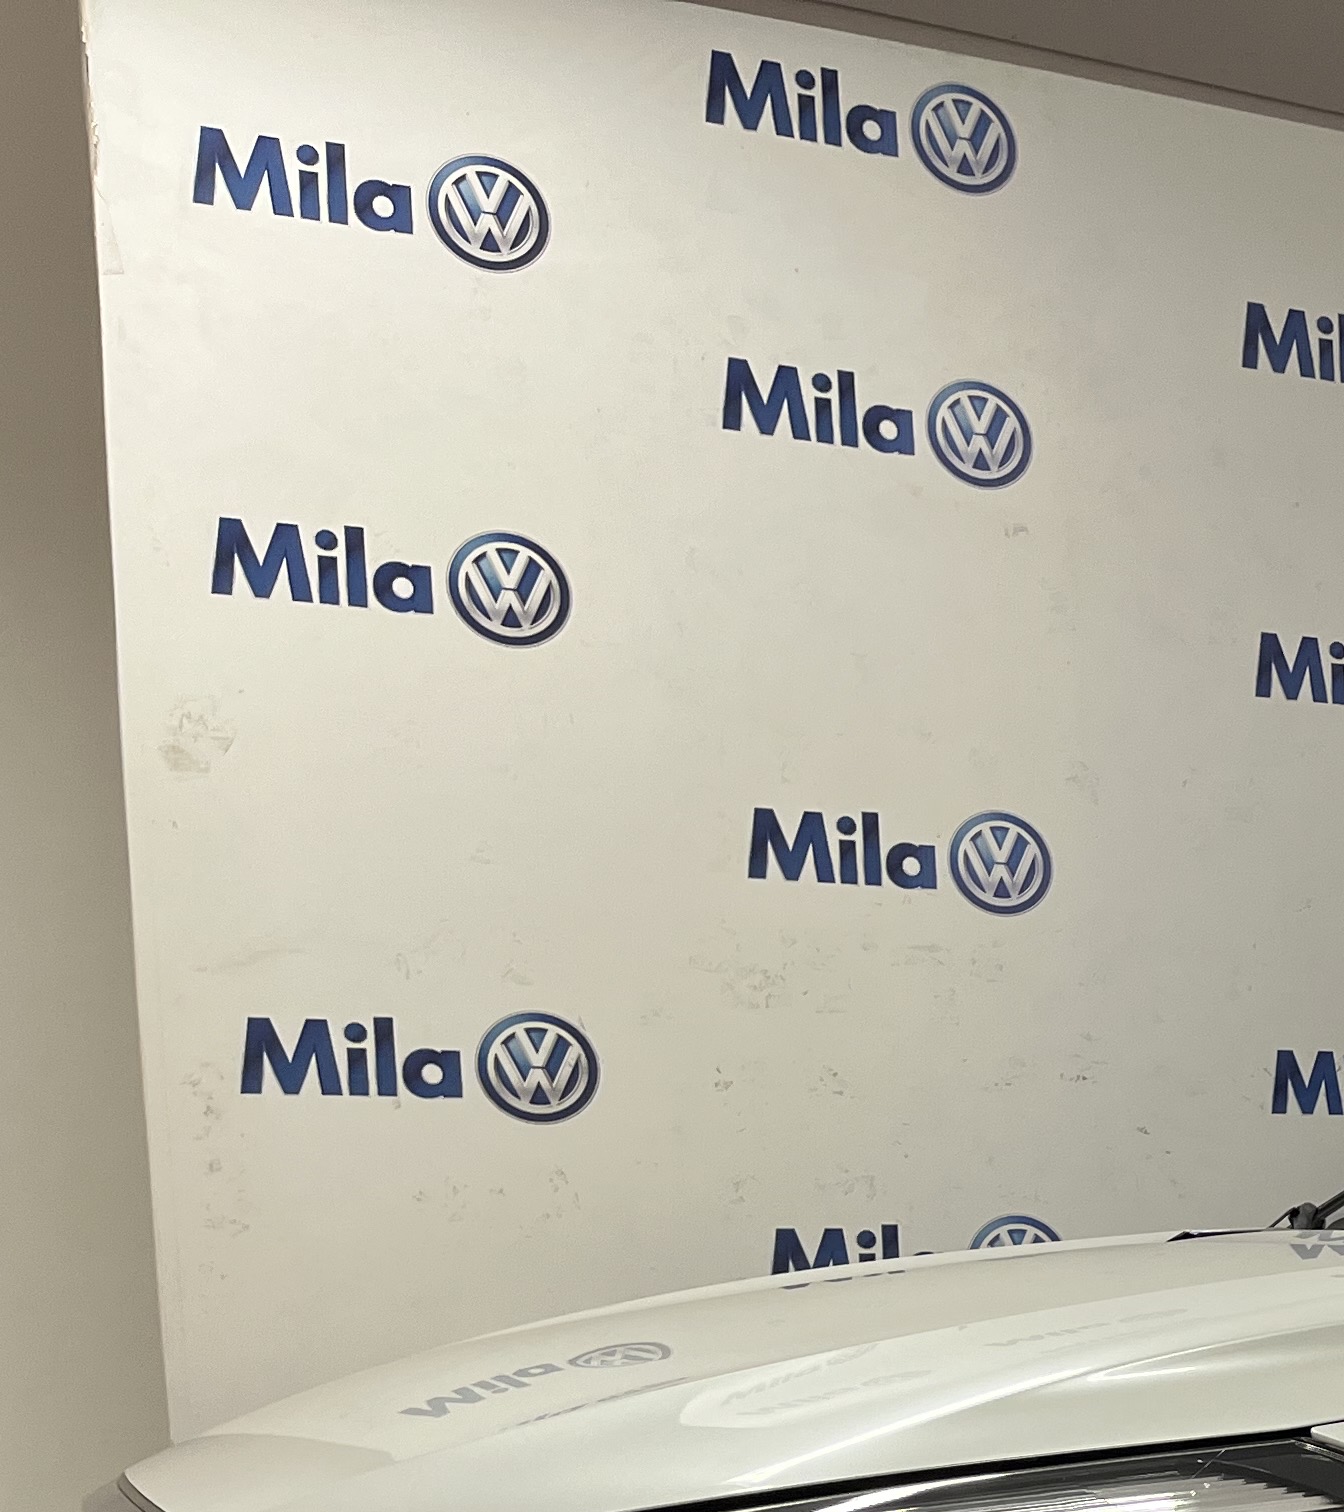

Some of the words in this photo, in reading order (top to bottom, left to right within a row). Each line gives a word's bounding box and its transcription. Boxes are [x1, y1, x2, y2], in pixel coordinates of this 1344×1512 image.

[706, 50, 898, 157] Mila
[918, 90, 1010, 186] VW
[193, 126, 413, 234] Mila
[436, 164, 541, 263] VW
[723, 357, 915, 455] Mila
[934, 389, 1025, 481] VW
[211, 517, 434, 614] Mila
[457, 541, 561, 639] VW
[748, 808, 937, 889] Mila
[957, 819, 1045, 909] VW
[241, 1017, 463, 1098] Mila
[485, 1021, 591, 1117] VW
